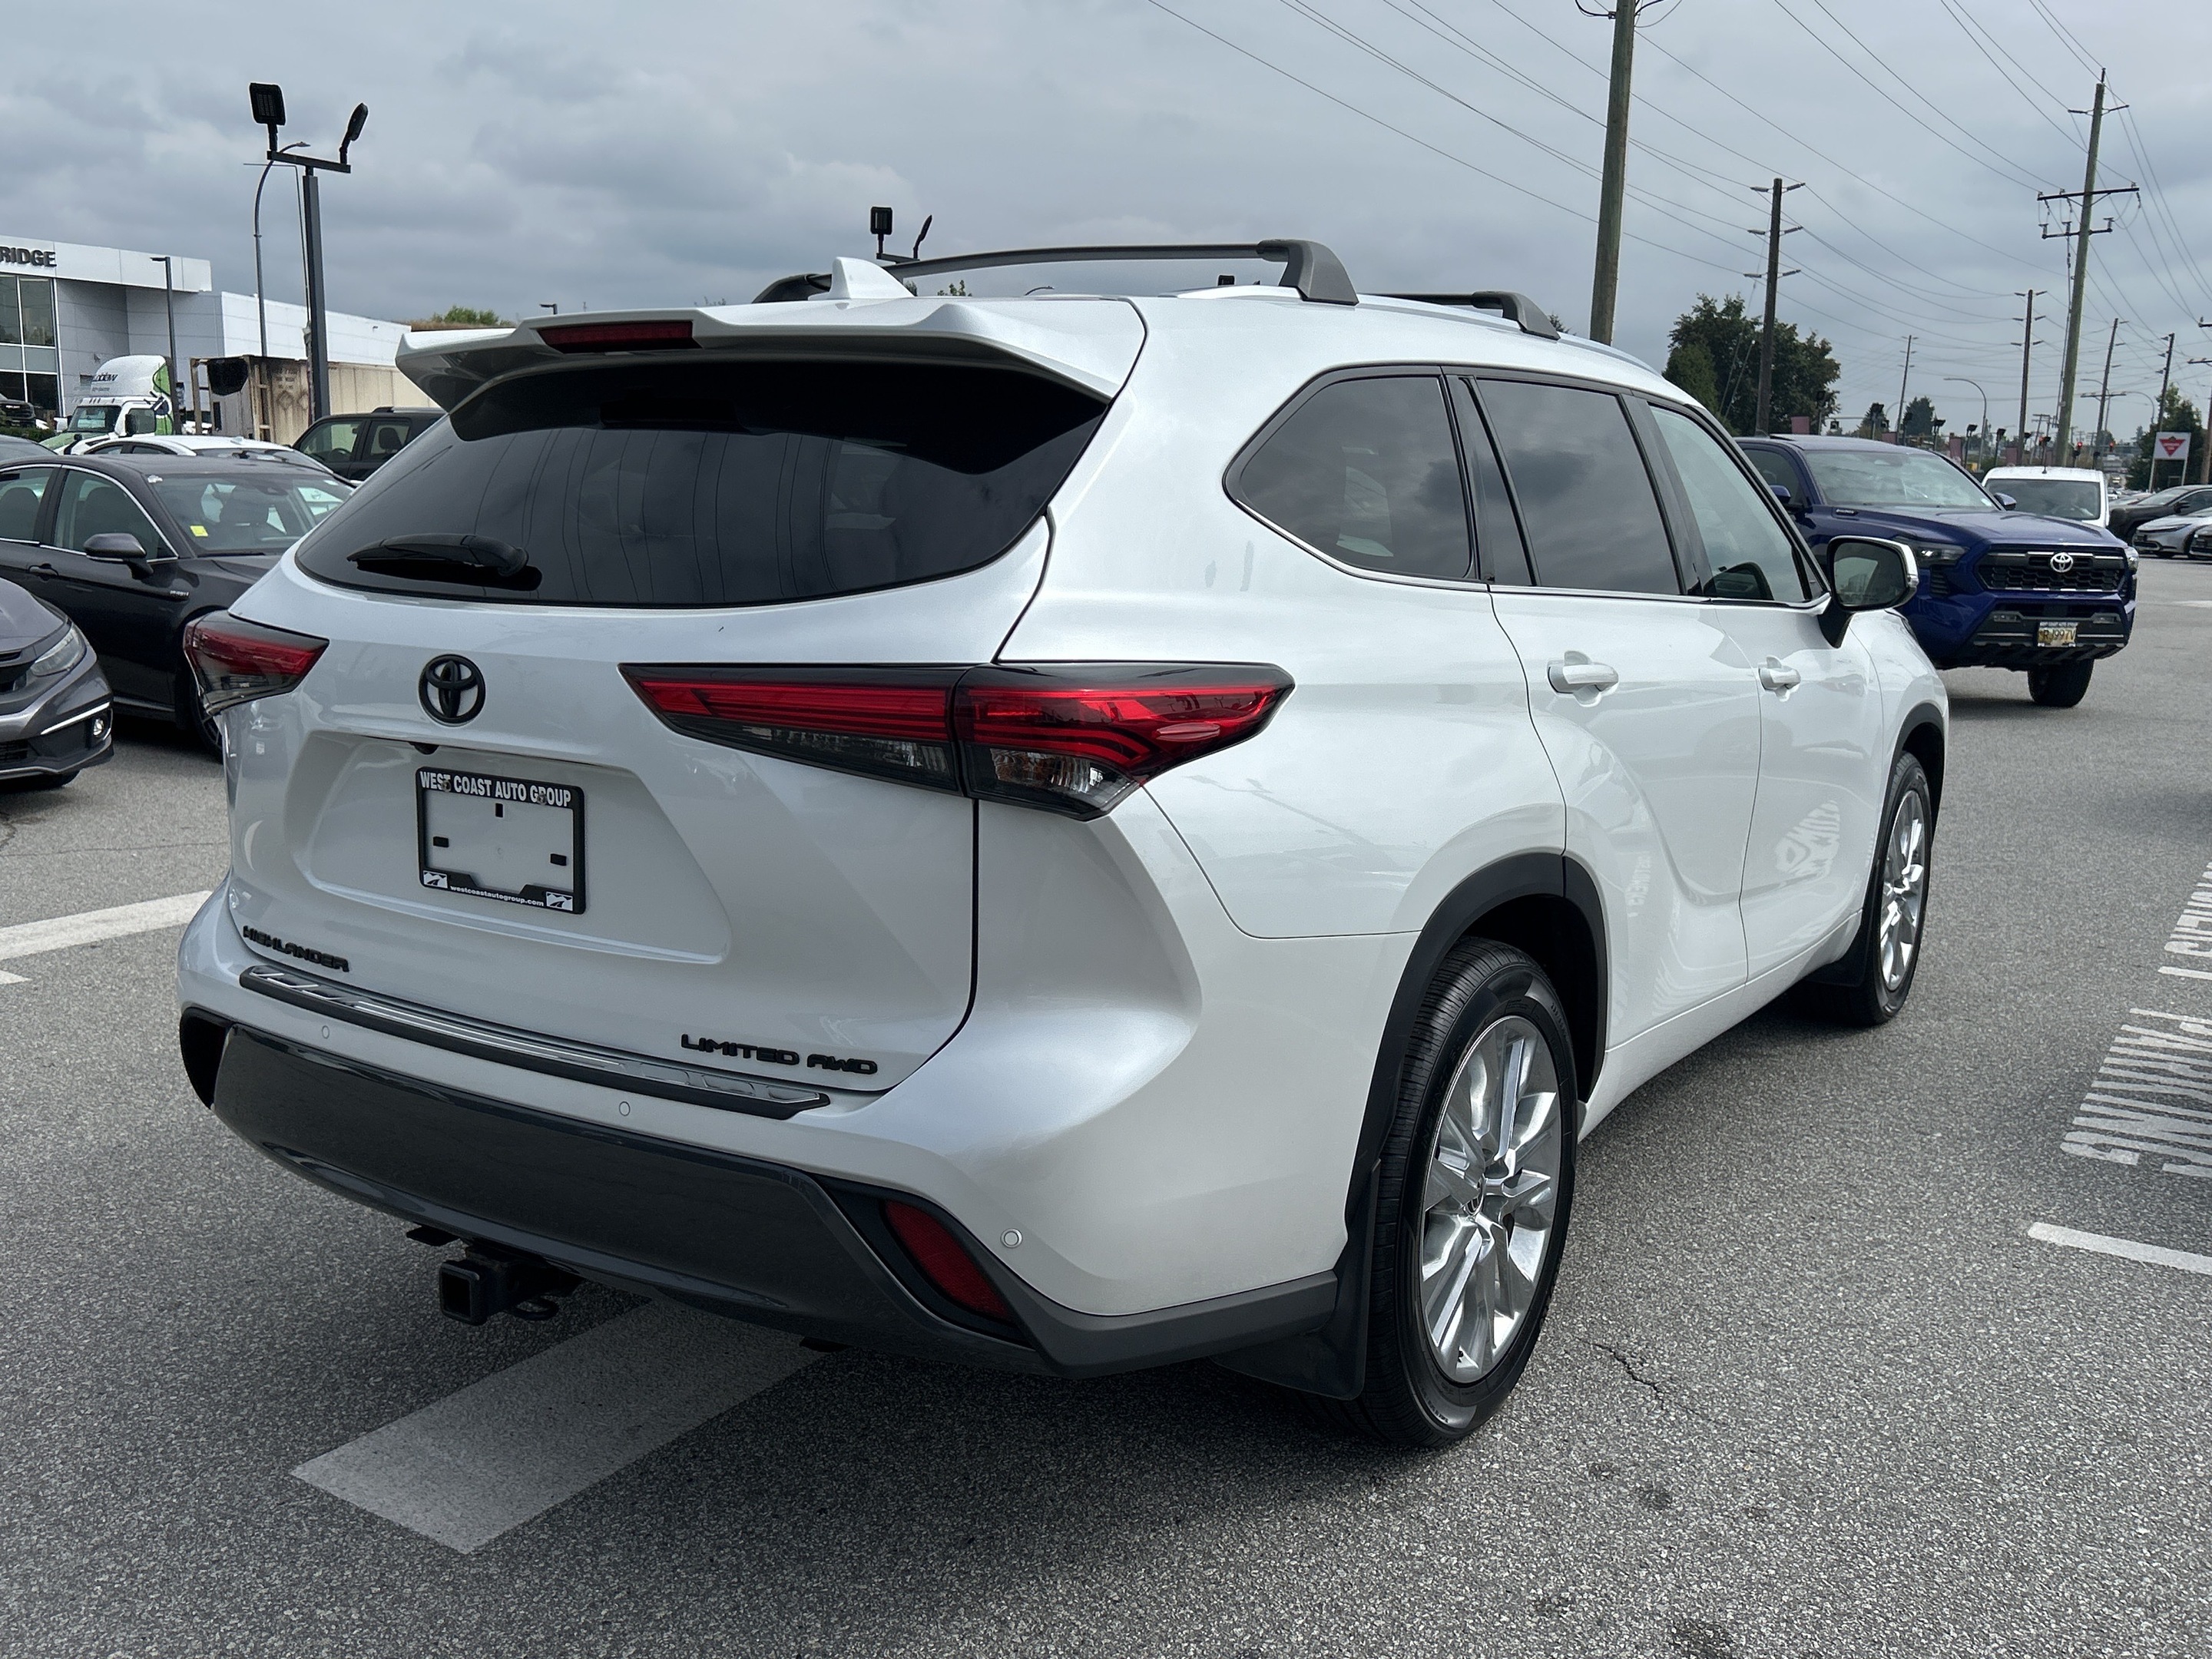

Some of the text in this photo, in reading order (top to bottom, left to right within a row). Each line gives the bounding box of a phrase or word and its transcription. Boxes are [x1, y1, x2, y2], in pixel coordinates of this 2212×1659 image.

[0, 246, 58, 267] RIDGE
[453, 775, 492, 796] COAST
[495, 780, 527, 801] AUTO
[450, 886, 545, 906] westcoastautogroup.com
[243, 925, 350, 973] HIGHLANDER
[680, 1034, 878, 1075] LIMITED AWD
